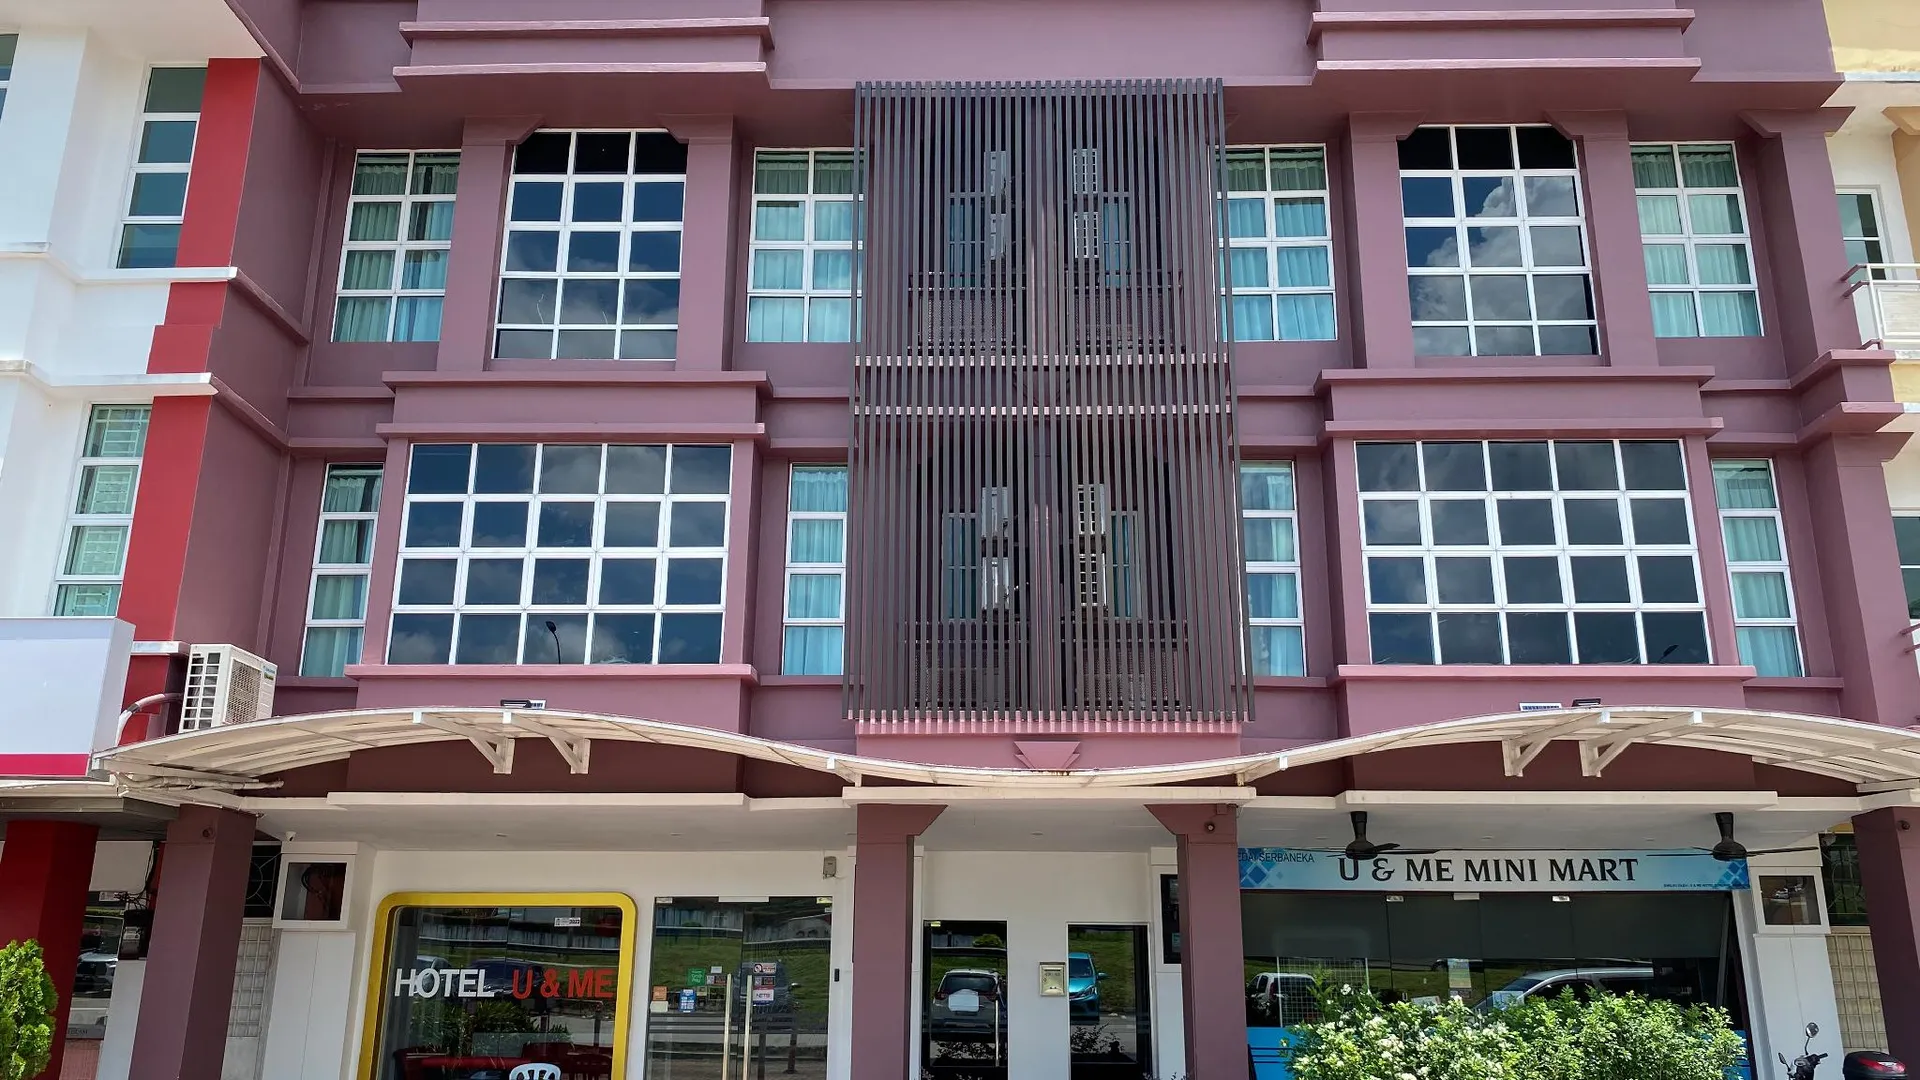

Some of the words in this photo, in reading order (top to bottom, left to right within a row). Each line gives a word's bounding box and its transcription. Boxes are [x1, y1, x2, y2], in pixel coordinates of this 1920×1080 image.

[1259, 852, 1315, 863] SERBANEKA
[1337, 857, 1359, 881] U
[1371, 857, 1396, 882] &
[1405, 857, 1453, 882] ME
[1464, 858, 1538, 882] MINI
[1549, 857, 1638, 882] MART
[394, 968, 495, 999] HOTEL
[512, 968, 533, 999] U
[540, 968, 560, 998] &
[567, 969, 616, 998] ME
